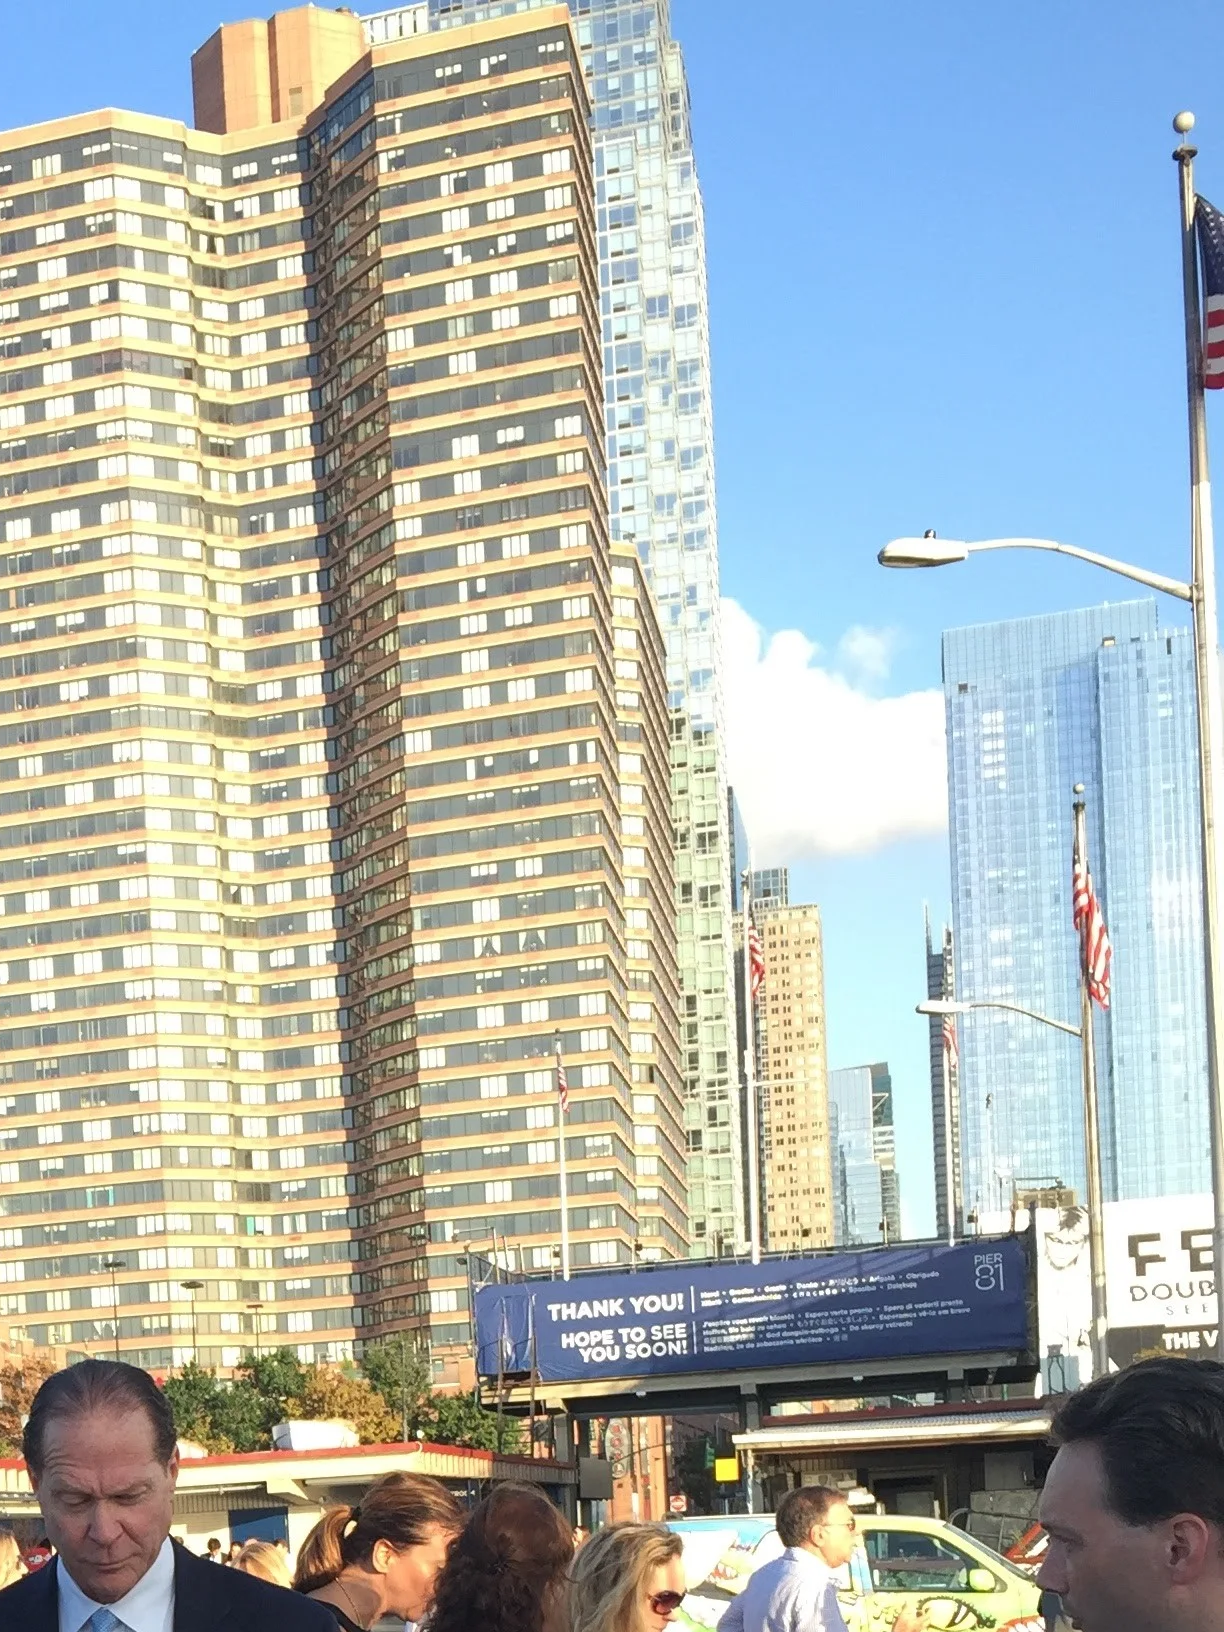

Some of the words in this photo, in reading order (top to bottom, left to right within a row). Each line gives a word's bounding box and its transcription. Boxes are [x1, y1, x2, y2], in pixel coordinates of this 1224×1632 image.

[974, 1253, 1003, 1265] PIER
[974, 1263, 1004, 1291] 81
[547, 1298, 624, 1322] THANK
[629, 1293, 684, 1314] YOU!
[561, 1330, 614, 1348] HOPE
[618, 1326, 646, 1344] TO
[650, 1323, 687, 1340] SEE
[1162, 1331, 1200, 1350] THE
[578, 1345, 620, 1363] YOU
[625, 1340, 688, 1360] SOON!
